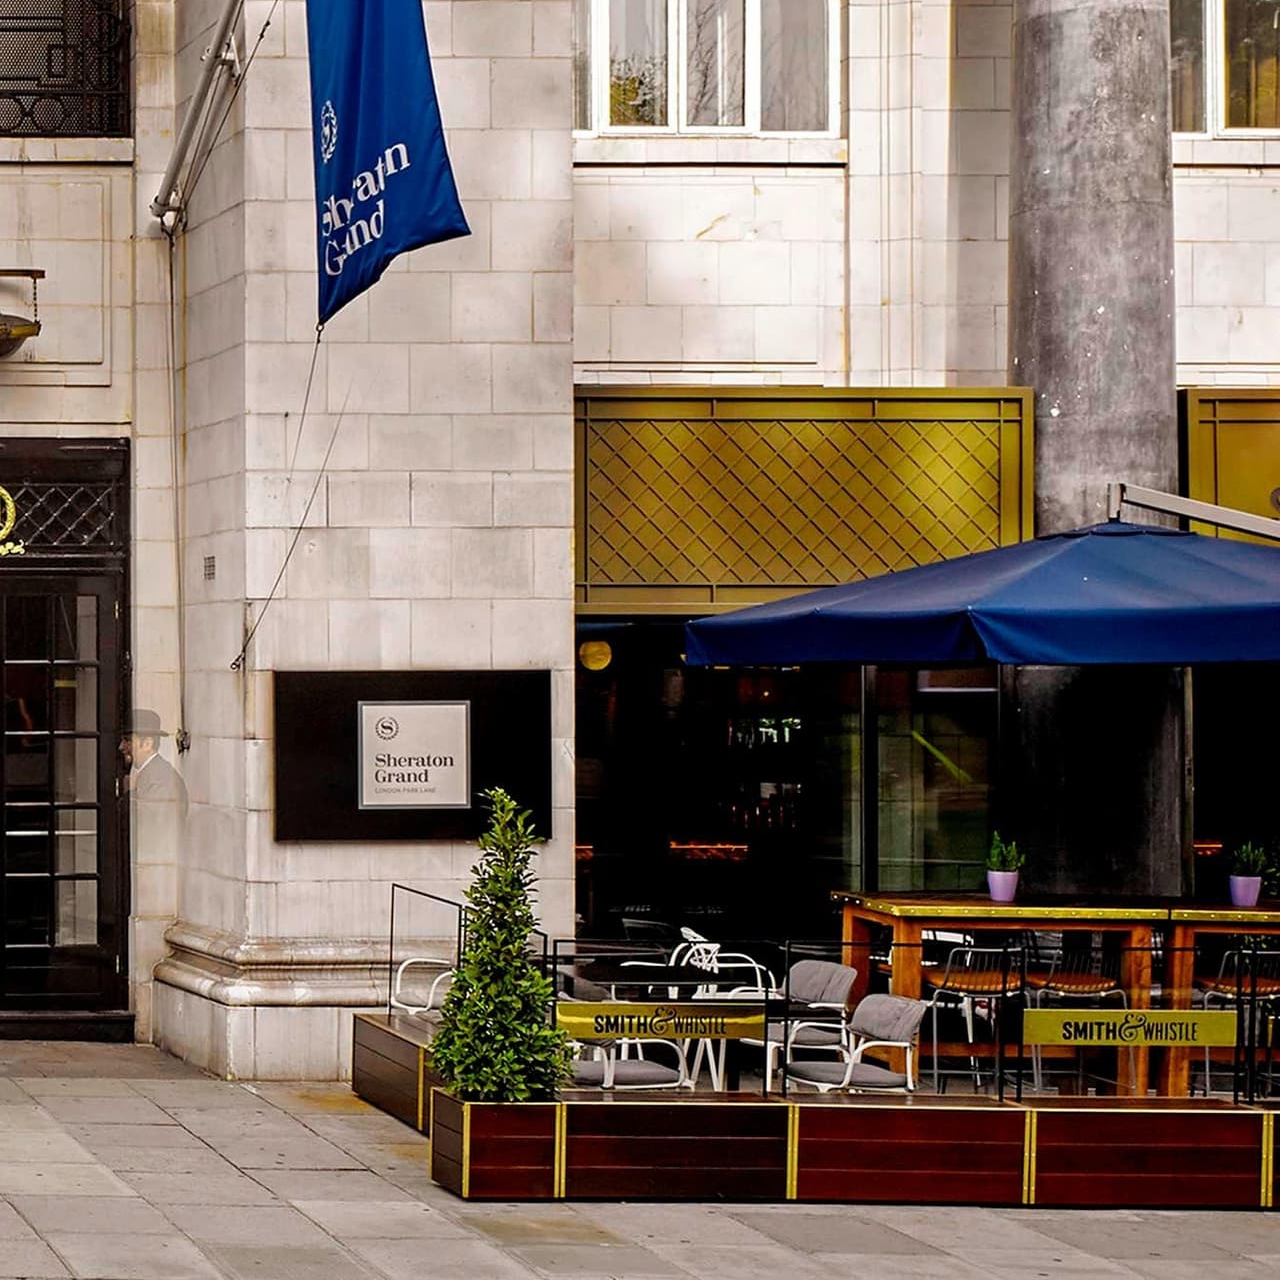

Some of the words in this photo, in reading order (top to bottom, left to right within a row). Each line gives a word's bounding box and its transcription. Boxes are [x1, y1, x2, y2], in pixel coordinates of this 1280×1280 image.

[374, 753, 454, 768] Sheraton
[374, 769, 429, 783] Grand
[593, 1014, 648, 1035] SMITH
[649, 1006, 678, 1036] &
[673, 1014, 727, 1035] WHISTLE
[1061, 1021, 1117, 1040] SMITH
[1118, 1013, 1147, 1042] &
[1143, 1021, 1199, 1041] WHISTLE
